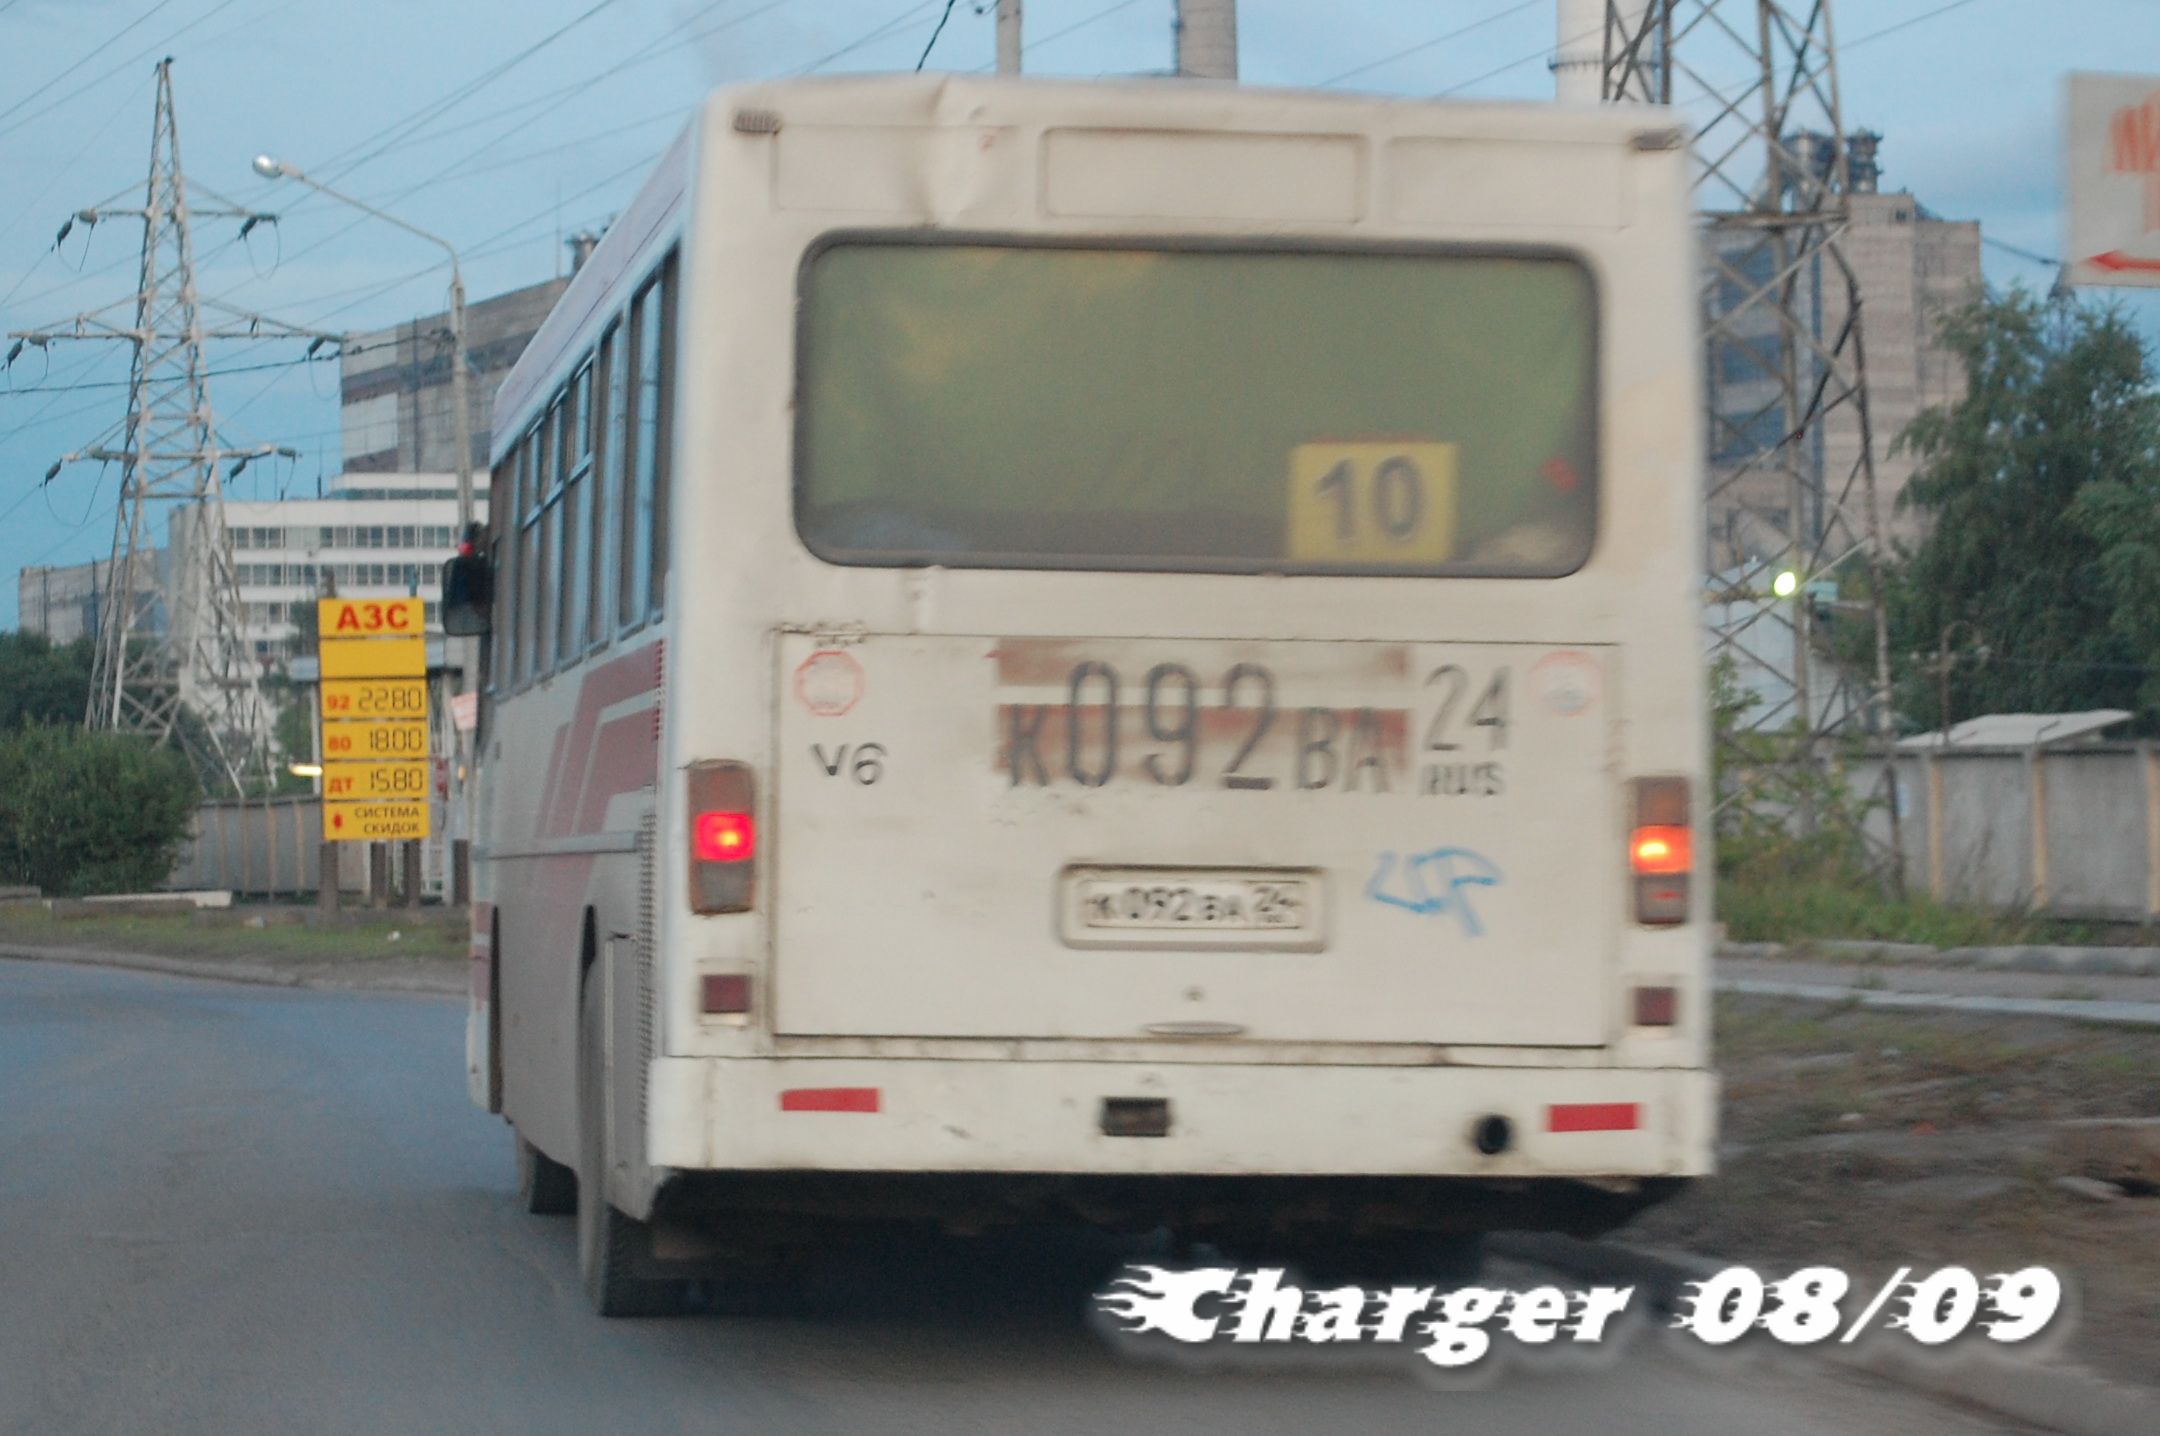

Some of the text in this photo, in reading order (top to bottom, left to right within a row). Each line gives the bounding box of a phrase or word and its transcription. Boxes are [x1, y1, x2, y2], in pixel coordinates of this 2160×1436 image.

[1315, 454, 1426, 540] 10
[336, 604, 409, 631] АЗС
[1424, 662, 1511, 751] 24
[810, 742, 888, 785] V6
[354, 807, 420, 818] СИСТЕМА
